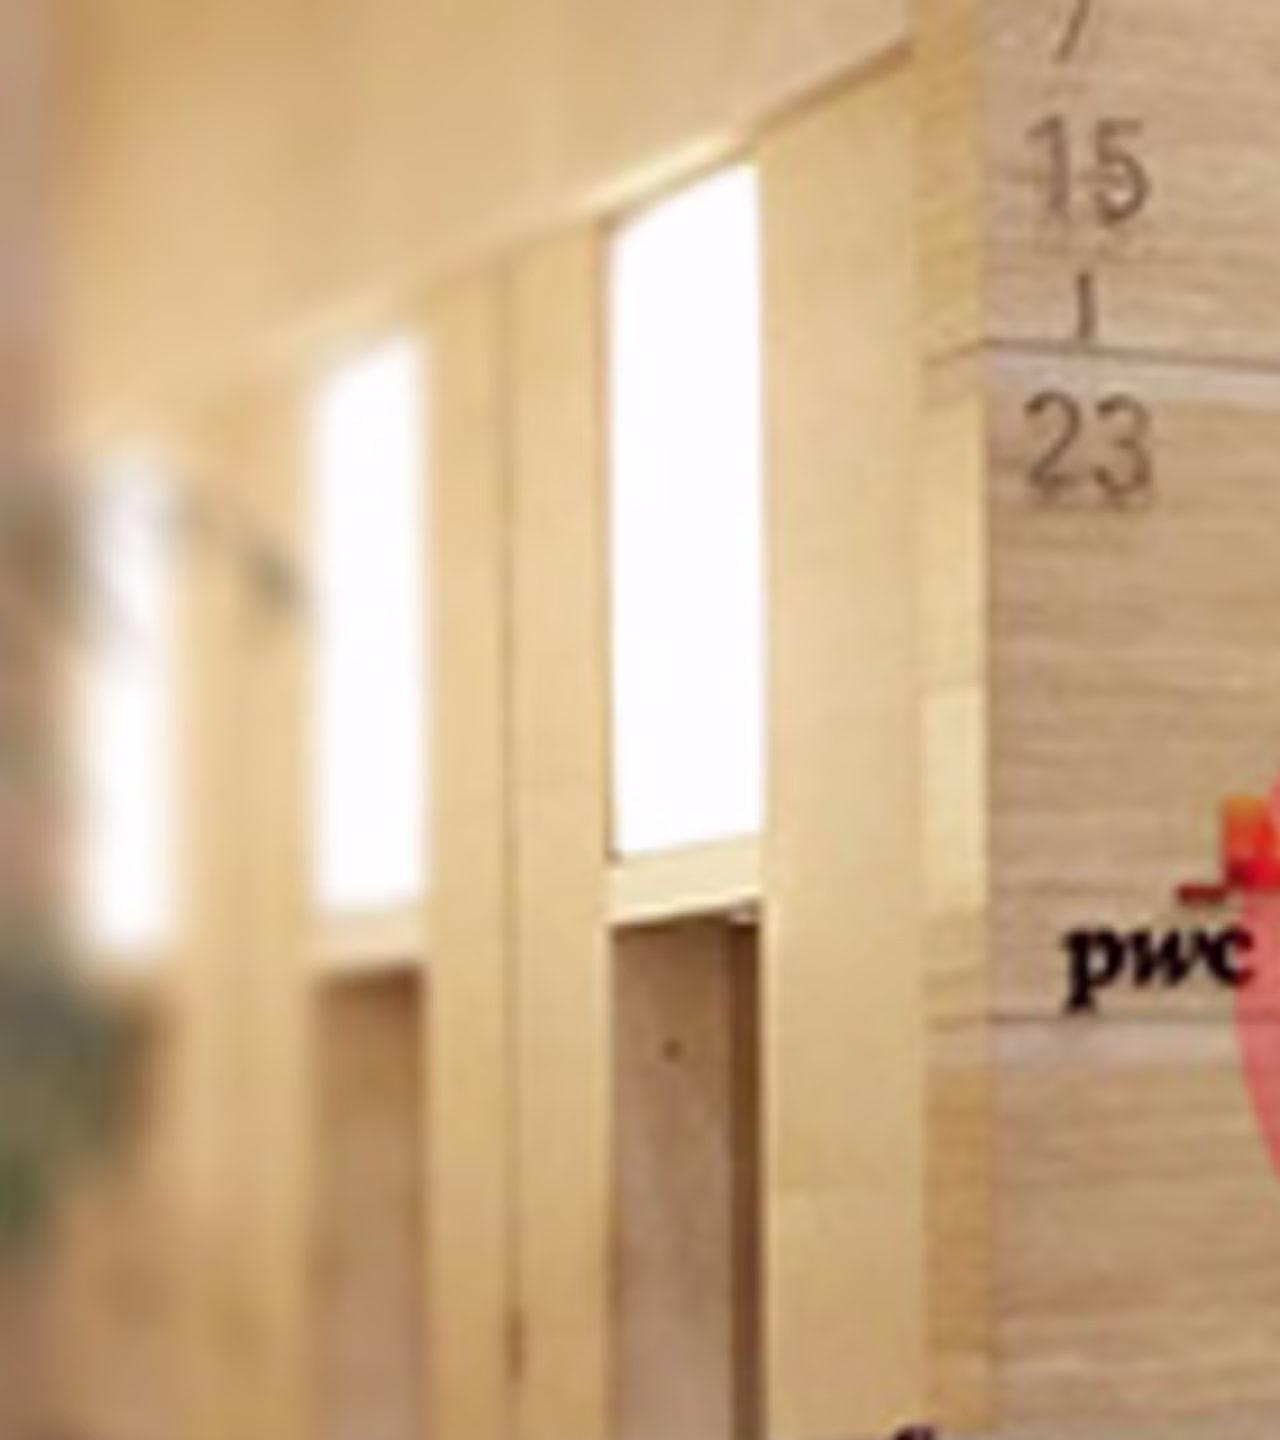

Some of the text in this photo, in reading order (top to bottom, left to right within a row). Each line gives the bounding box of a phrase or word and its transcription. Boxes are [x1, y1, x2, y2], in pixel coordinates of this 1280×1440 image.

[1025, 114, 1152, 228] 15
[1024, 391, 1154, 502] 23
[1060, 924, 1256, 1014] pwc
